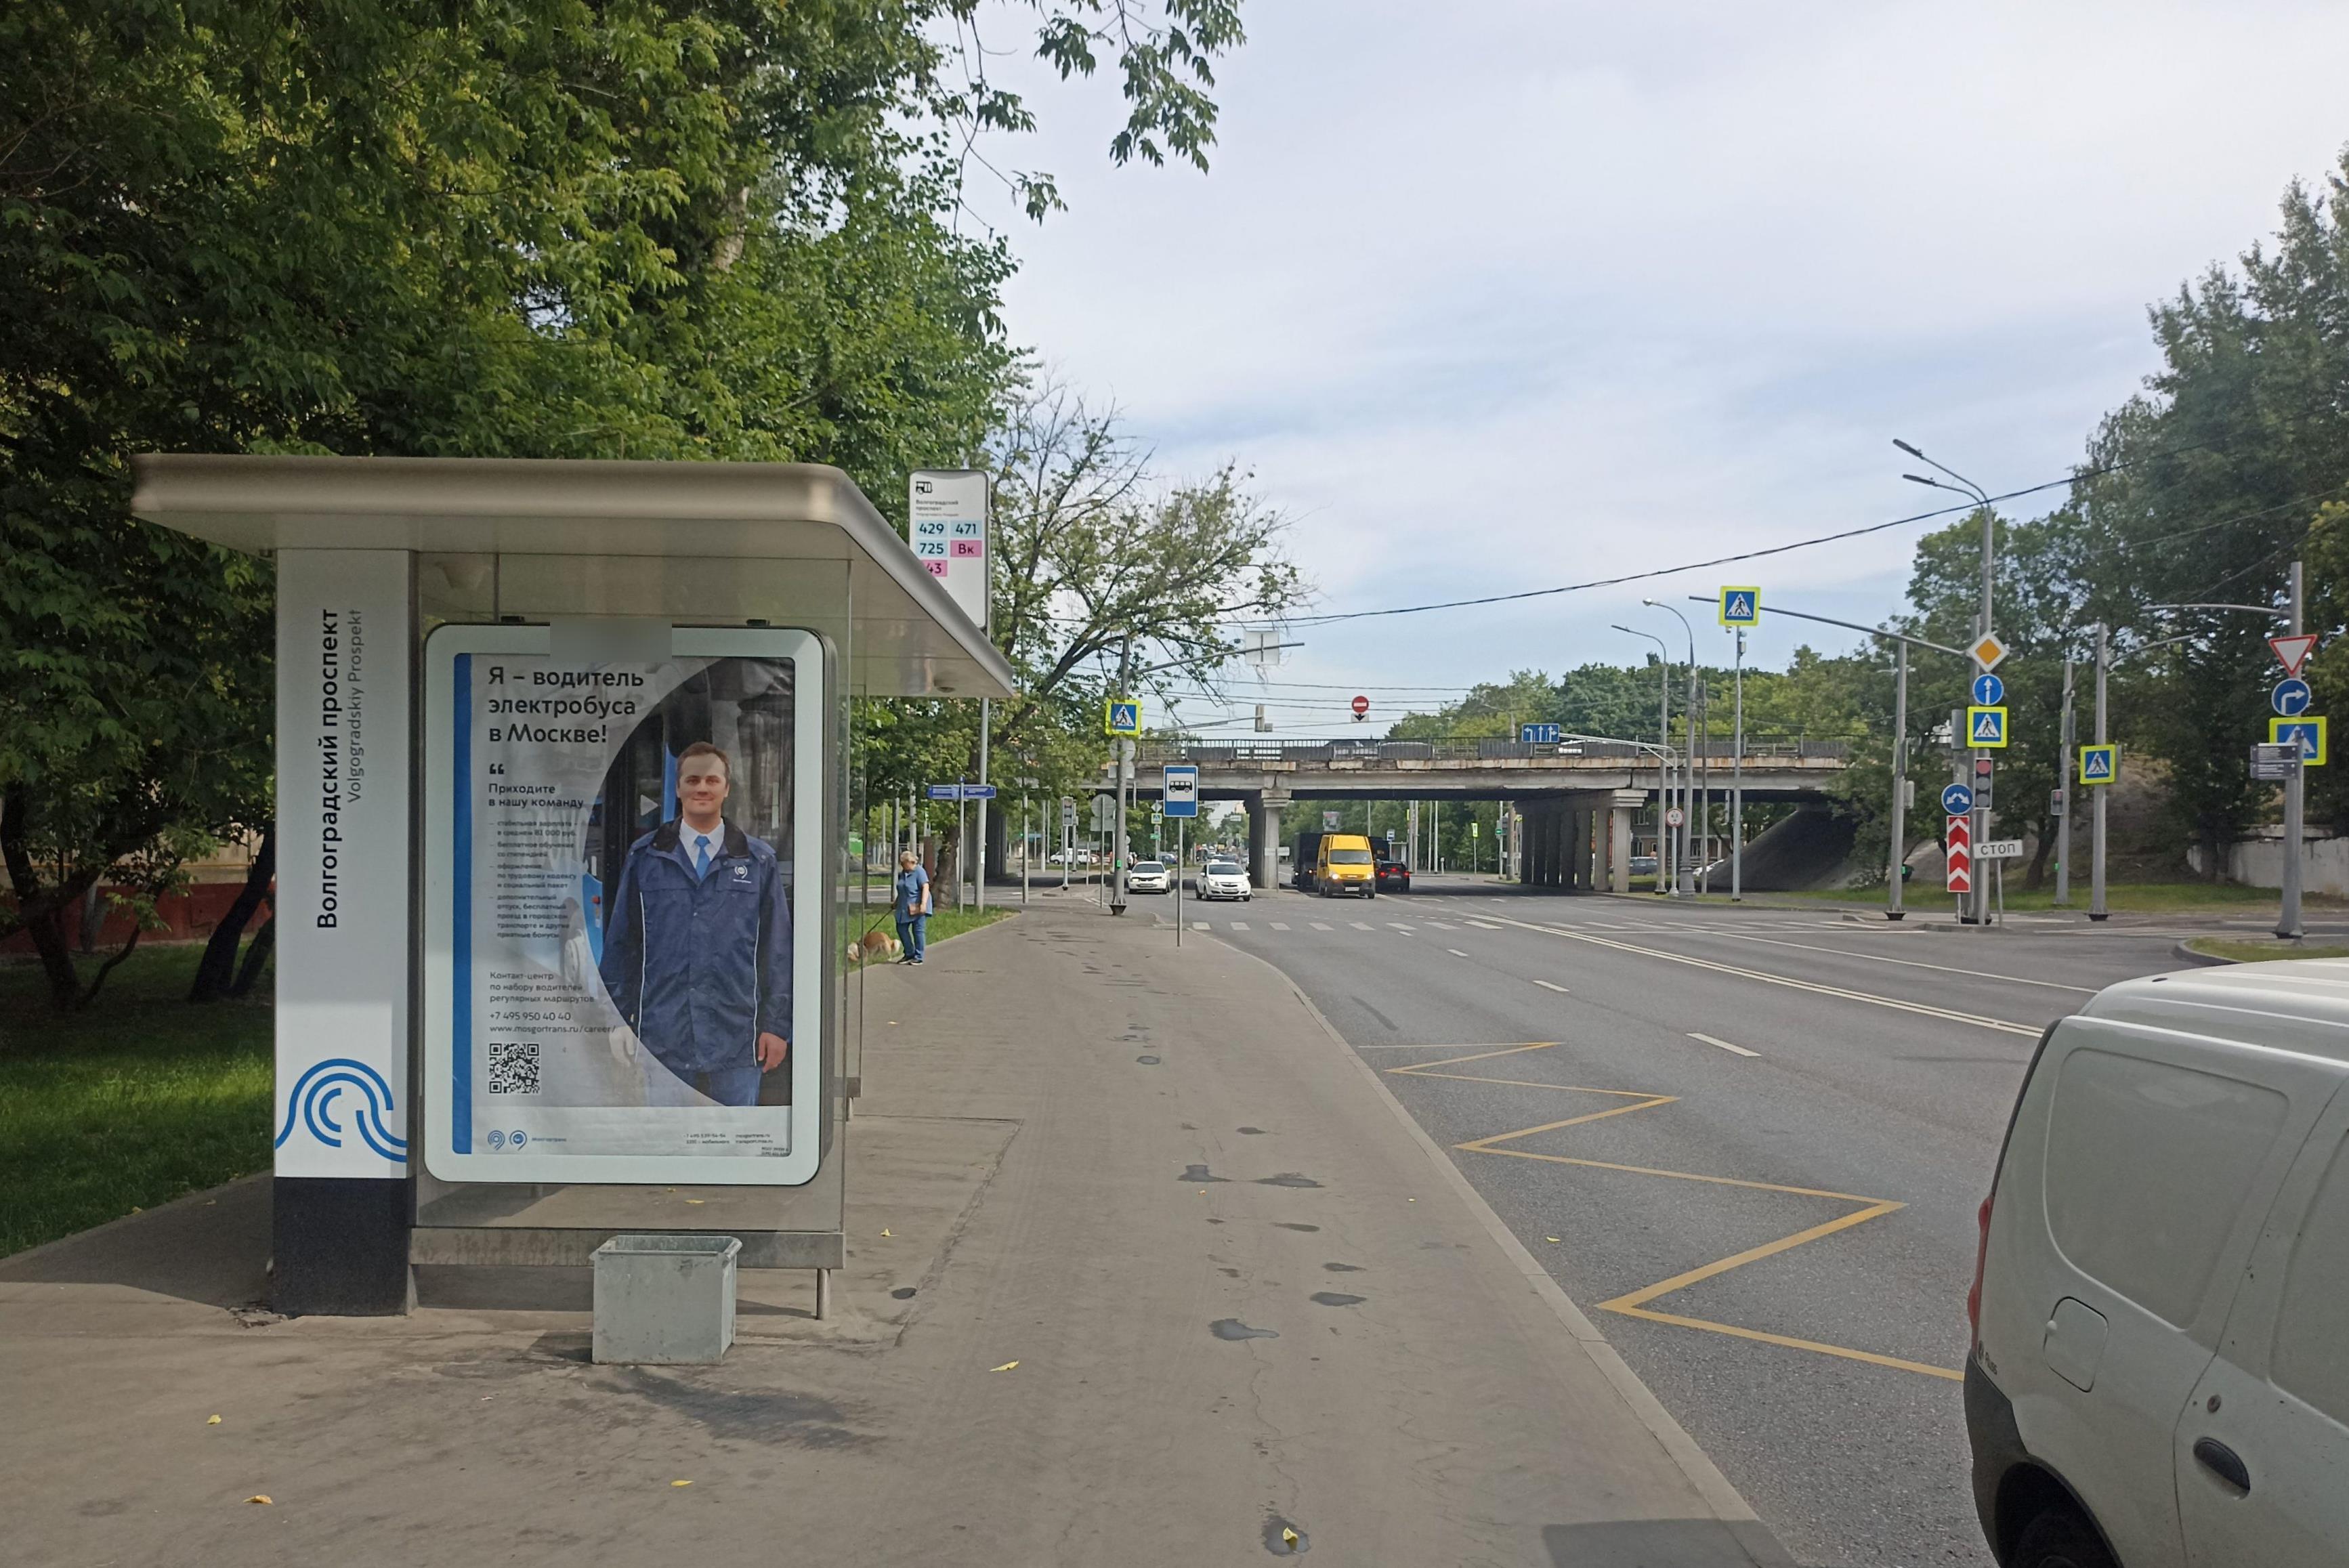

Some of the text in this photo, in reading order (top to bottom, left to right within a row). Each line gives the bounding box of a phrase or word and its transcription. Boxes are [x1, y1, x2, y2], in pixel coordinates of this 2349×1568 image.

[919, 524, 976, 534] 429 471
[920, 543, 974, 554] 725 Вк
[488, 666, 504, 685] Я
[533, 671, 643, 689] водитель
[347, 609, 364, 803] Volgogradskiy Prospekt
[488, 696, 635, 719] электробуса
[490, 723, 606, 743] в Москве!
[318, 609, 342, 927] Волгоградский проспект
[488, 784, 555, 797] Приходите
[499, 799, 528, 809] нашу
[531, 799, 584, 809] команду
[1981, 843, 2015, 855] СТОП
[490, 972, 554, 981] Контакт-центр
[503, 983, 534, 992] набору
[536, 983, 583, 992] водителей
[490, 996, 541, 1004] регулярных
[490, 1012, 571, 1021] +7 495 950 40 40
[490, 1025, 616, 1035] www.mosgortrans.ru/career/
